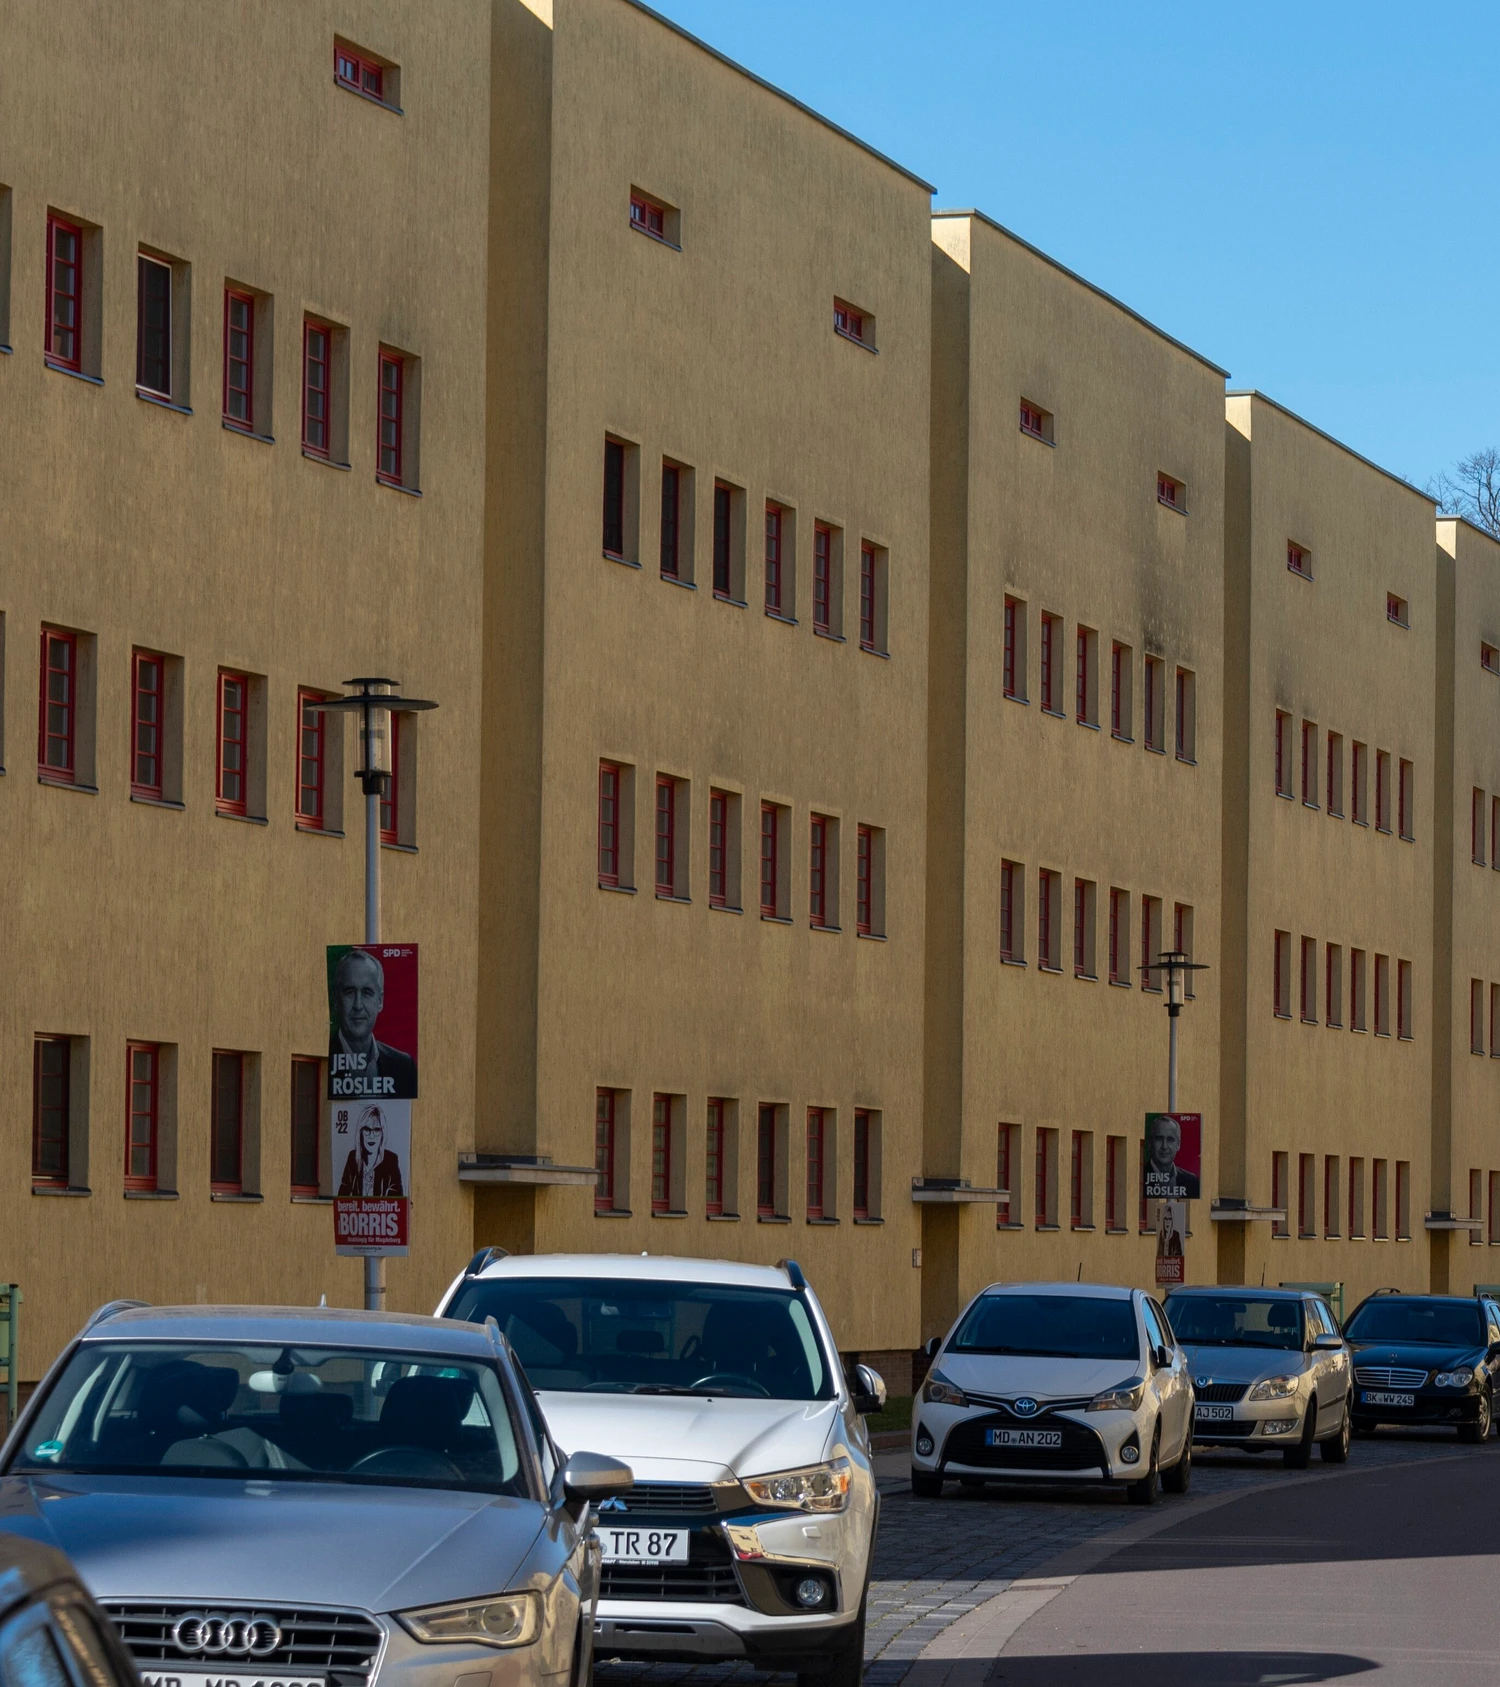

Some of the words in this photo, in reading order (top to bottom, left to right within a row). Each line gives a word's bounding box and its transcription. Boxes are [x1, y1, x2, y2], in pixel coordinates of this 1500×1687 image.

[383, 949, 400, 957] SPD
[331, 1053, 367, 1075] JENS
[333, 1073, 396, 1095] RÖSLER
[338, 1110, 348, 1122] OB
[1146, 1172, 1170, 1185] JENS
[1146, 1184, 1187, 1196] RÖSLER
[338, 1201, 359, 1212] bereit.
[362, 1201, 400, 1212] bewährt.
[340, 1213, 398, 1236] BORRIS
[1196, 1407, 1209, 1418] AJ
[1211, 1408, 1230, 1418] 502
[994, 1431, 1010, 1444] MD
[1019, 1432, 1034, 1444] AN
[1037, 1432, 1060, 1446] 202
[610, 1531, 640, 1555] TR
[647, 1532, 678, 1556] 87
